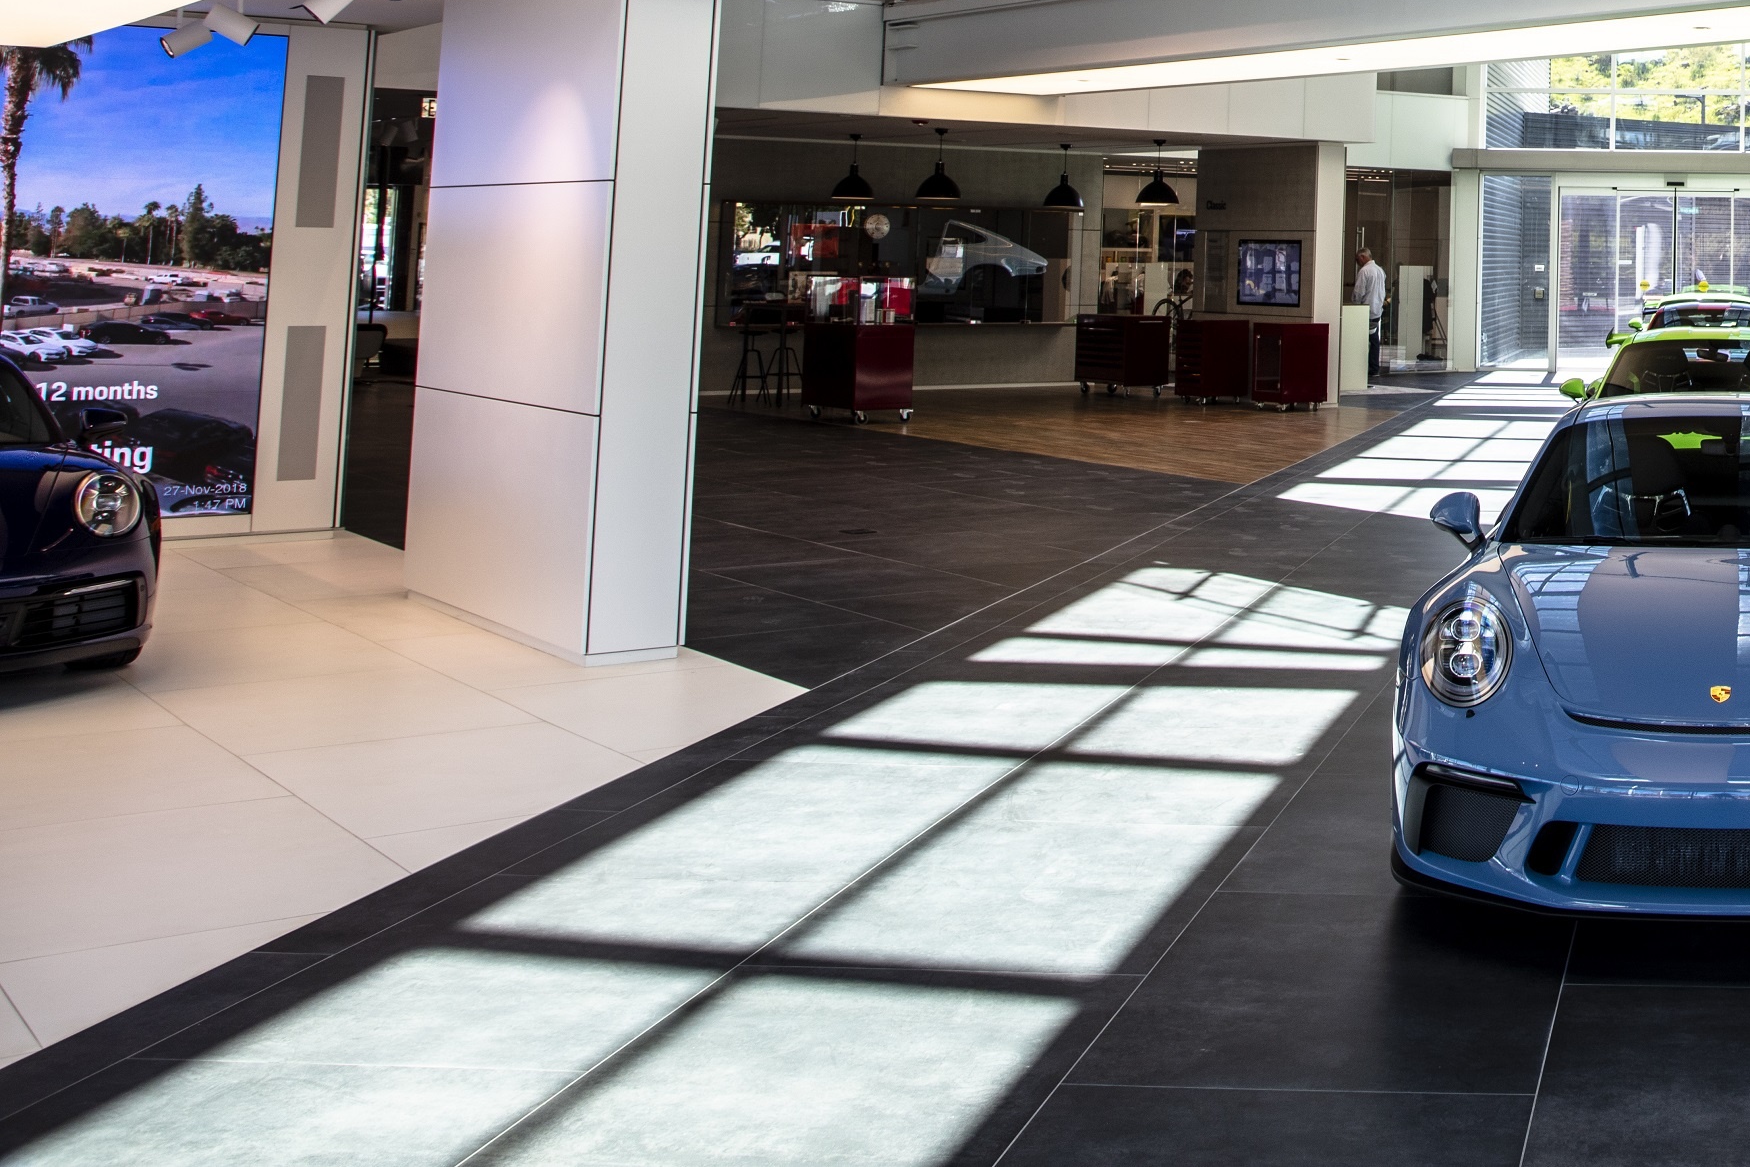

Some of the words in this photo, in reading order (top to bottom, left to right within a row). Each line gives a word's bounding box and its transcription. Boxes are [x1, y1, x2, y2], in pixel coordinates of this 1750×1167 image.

[36, 381, 67, 401] 12
[72, 381, 159, 401] months
[163, 483, 247, 496] 27-Nov-2018
[193, 499, 221, 511] 1:47
[225, 497, 247, 509] PM
